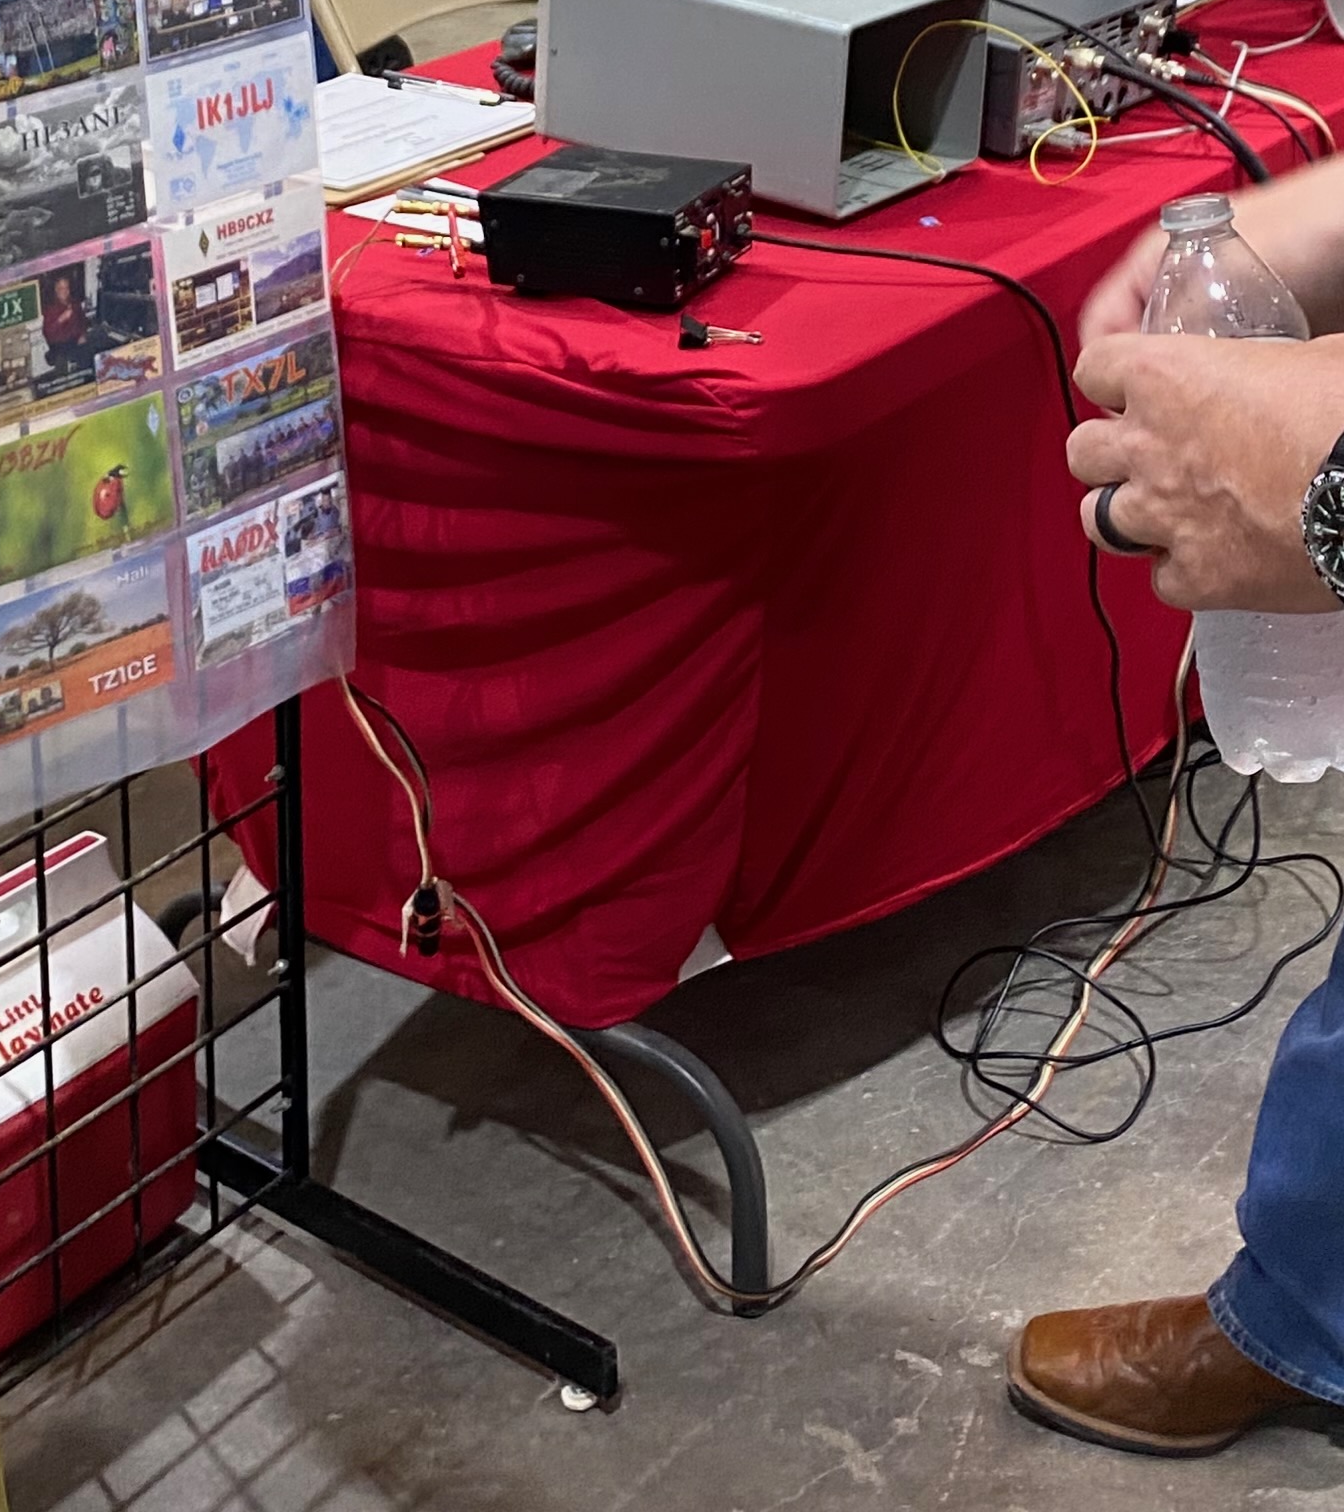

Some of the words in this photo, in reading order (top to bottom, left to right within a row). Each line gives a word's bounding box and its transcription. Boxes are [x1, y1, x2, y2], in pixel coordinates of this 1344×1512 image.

[196, 77, 275, 131] IK1JLJ
[216, 207, 275, 241] HB9CXZ
[219, 350, 307, 405] TX7L
[116, 566, 149, 588] Mali
